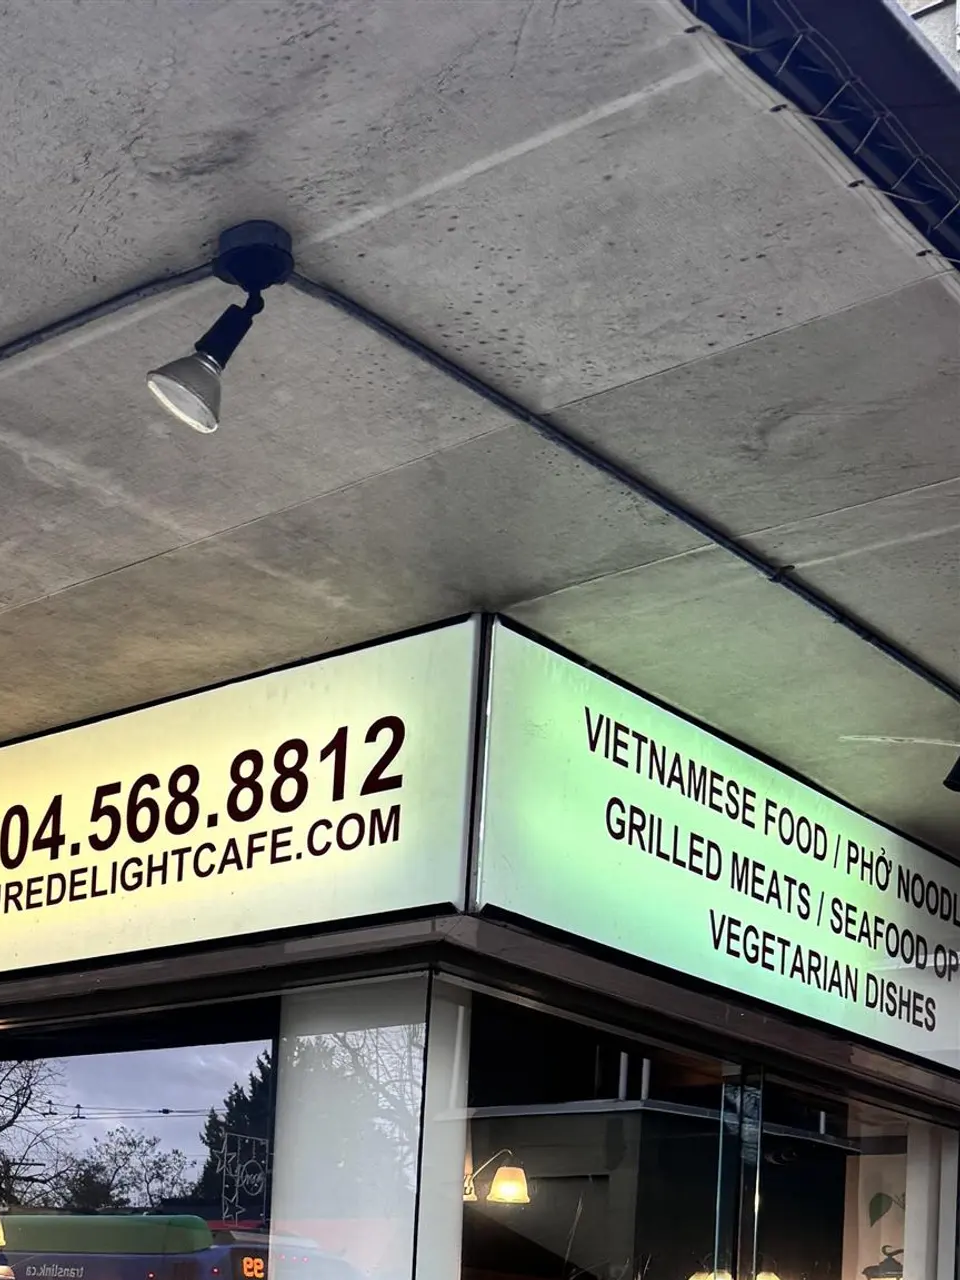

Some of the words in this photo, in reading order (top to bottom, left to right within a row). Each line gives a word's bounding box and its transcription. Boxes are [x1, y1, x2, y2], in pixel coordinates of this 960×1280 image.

[584, 706, 756, 829] VIETNAMESE
[764, 798, 828, 862] FOOD
[846, 839, 892, 891] PHỞ
[606, 796, 722, 881] GRILLED
[731, 852, 811, 920] MEATS
[830, 897, 928, 970] SEAFOOD
[709, 909, 859, 1002] VEGETARIAN
[865, 973, 937, 1032] DISHES
